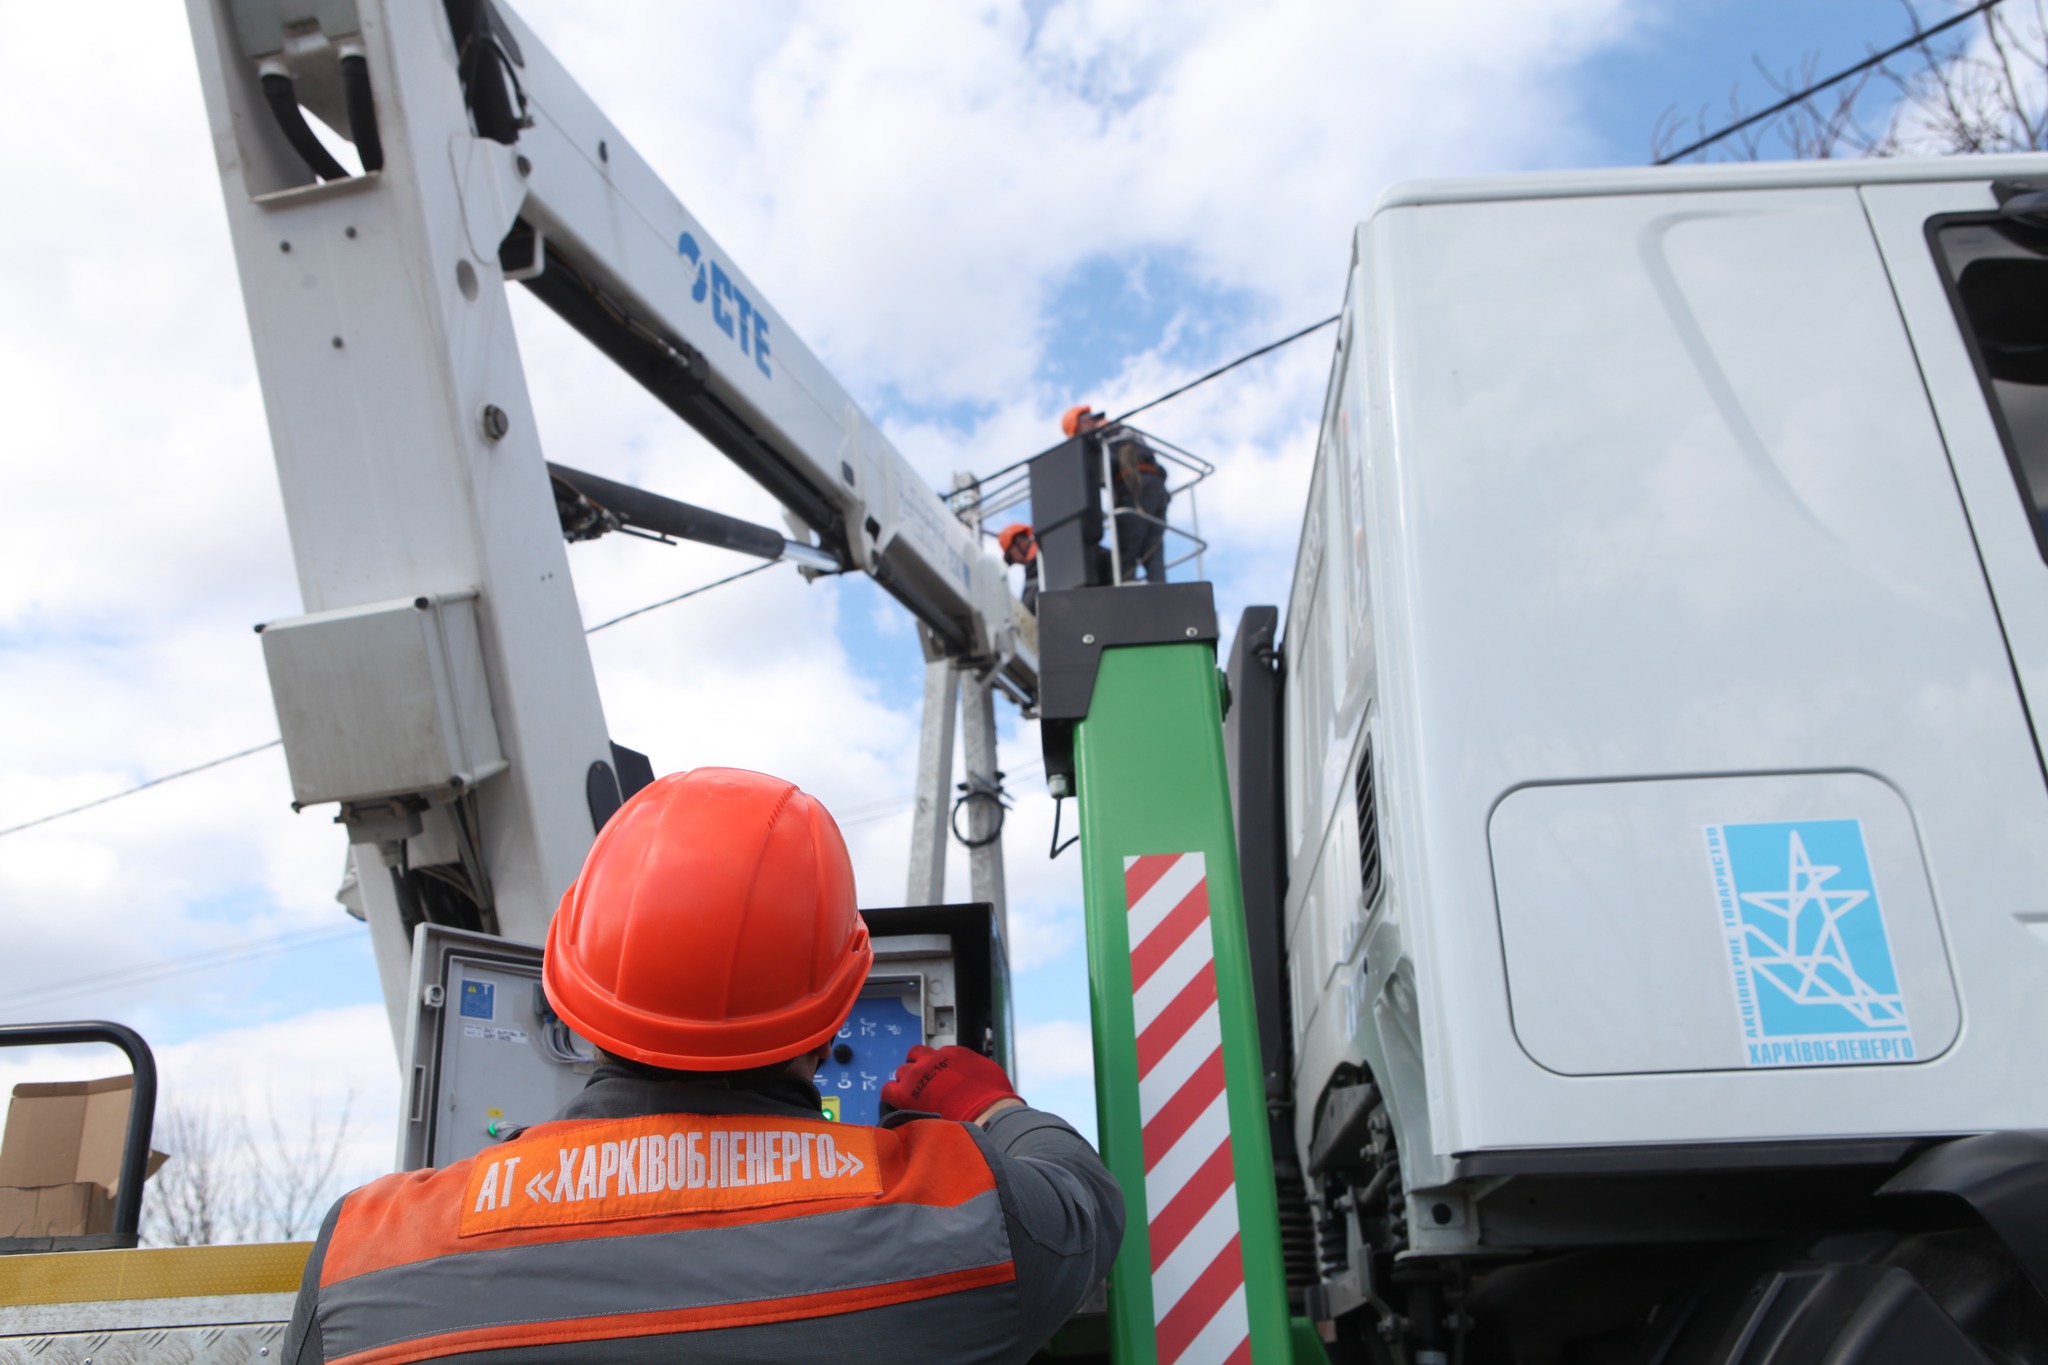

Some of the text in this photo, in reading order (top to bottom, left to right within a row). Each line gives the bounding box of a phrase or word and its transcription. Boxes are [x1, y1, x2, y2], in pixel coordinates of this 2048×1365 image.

[710, 259, 772, 381] CTE
[1706, 827, 1758, 1038] АКЦІОНЕРНЕ ТОВАРИСТВО
[1748, 1037, 1914, 1066] ХАРКІВОБЛЕНЕРГО
[474, 1131, 864, 1213] АТ «ХАРКІВОБЛЕНЕРГО»
